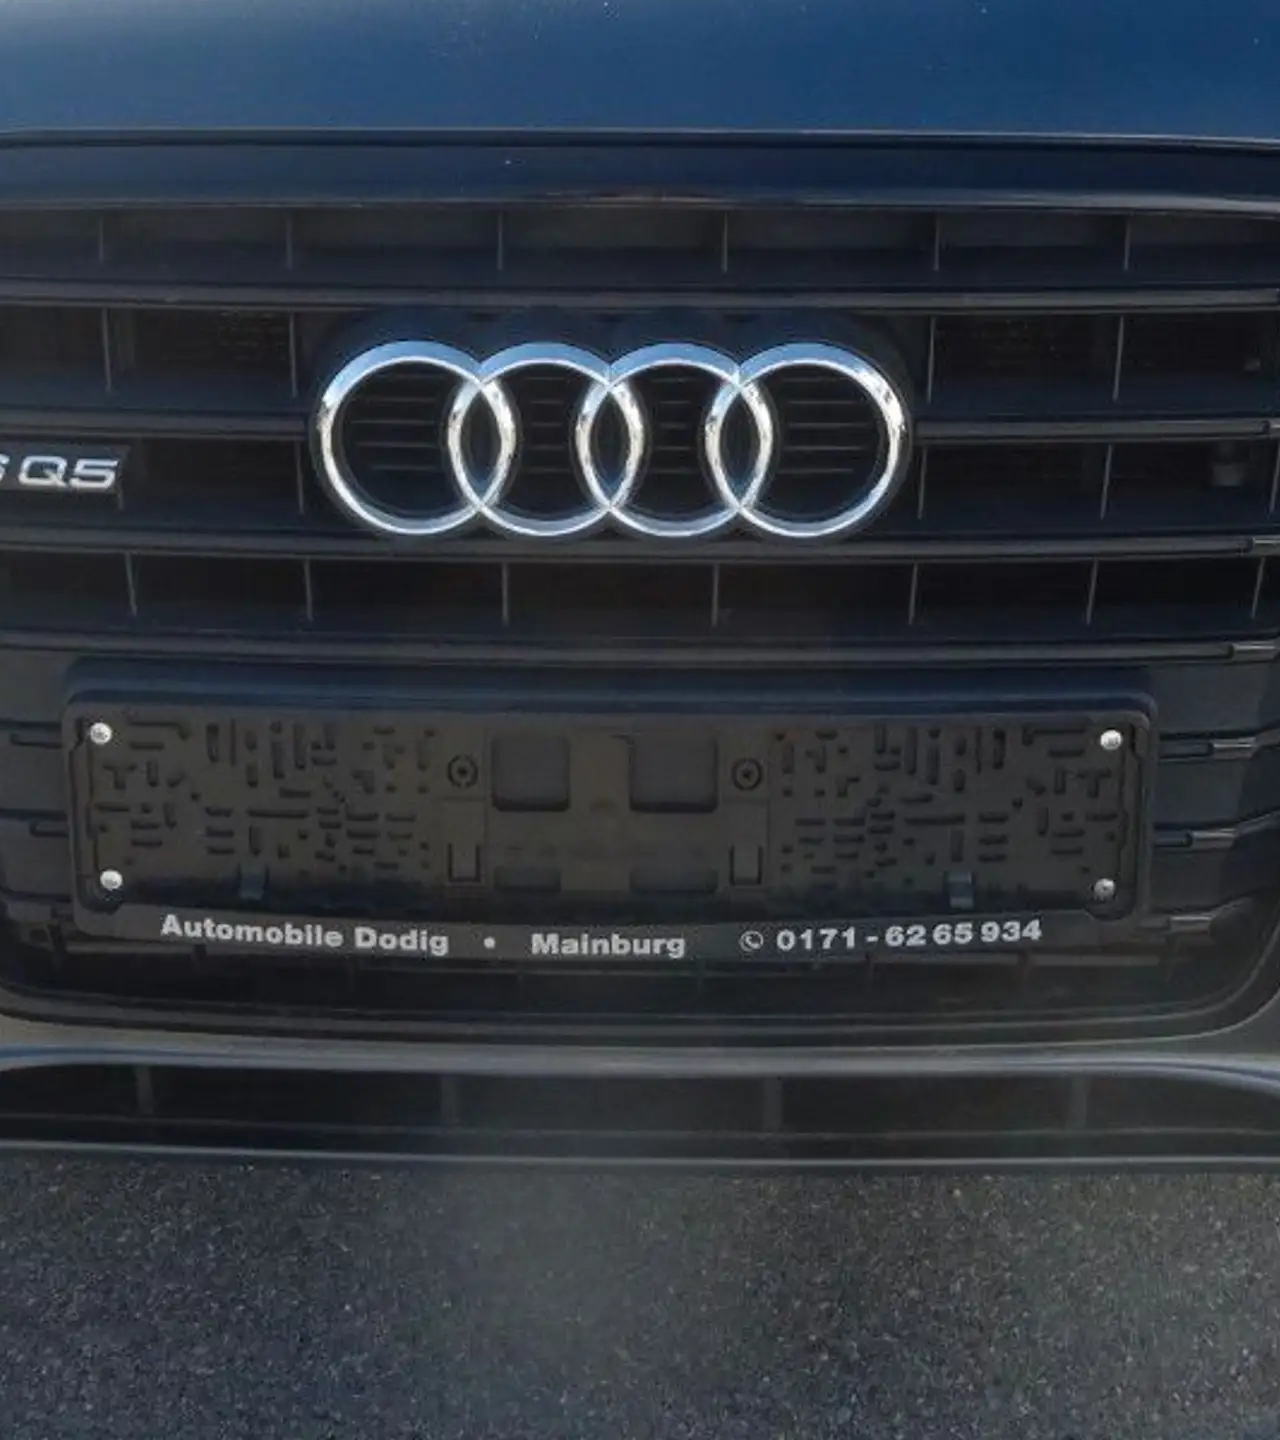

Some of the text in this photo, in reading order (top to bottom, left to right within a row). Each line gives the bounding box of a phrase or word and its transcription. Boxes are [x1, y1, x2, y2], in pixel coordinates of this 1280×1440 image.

[160, 913, 345, 948] Automobile
[354, 926, 450, 957] Dodig
[531, 932, 687, 959] Mainburg
